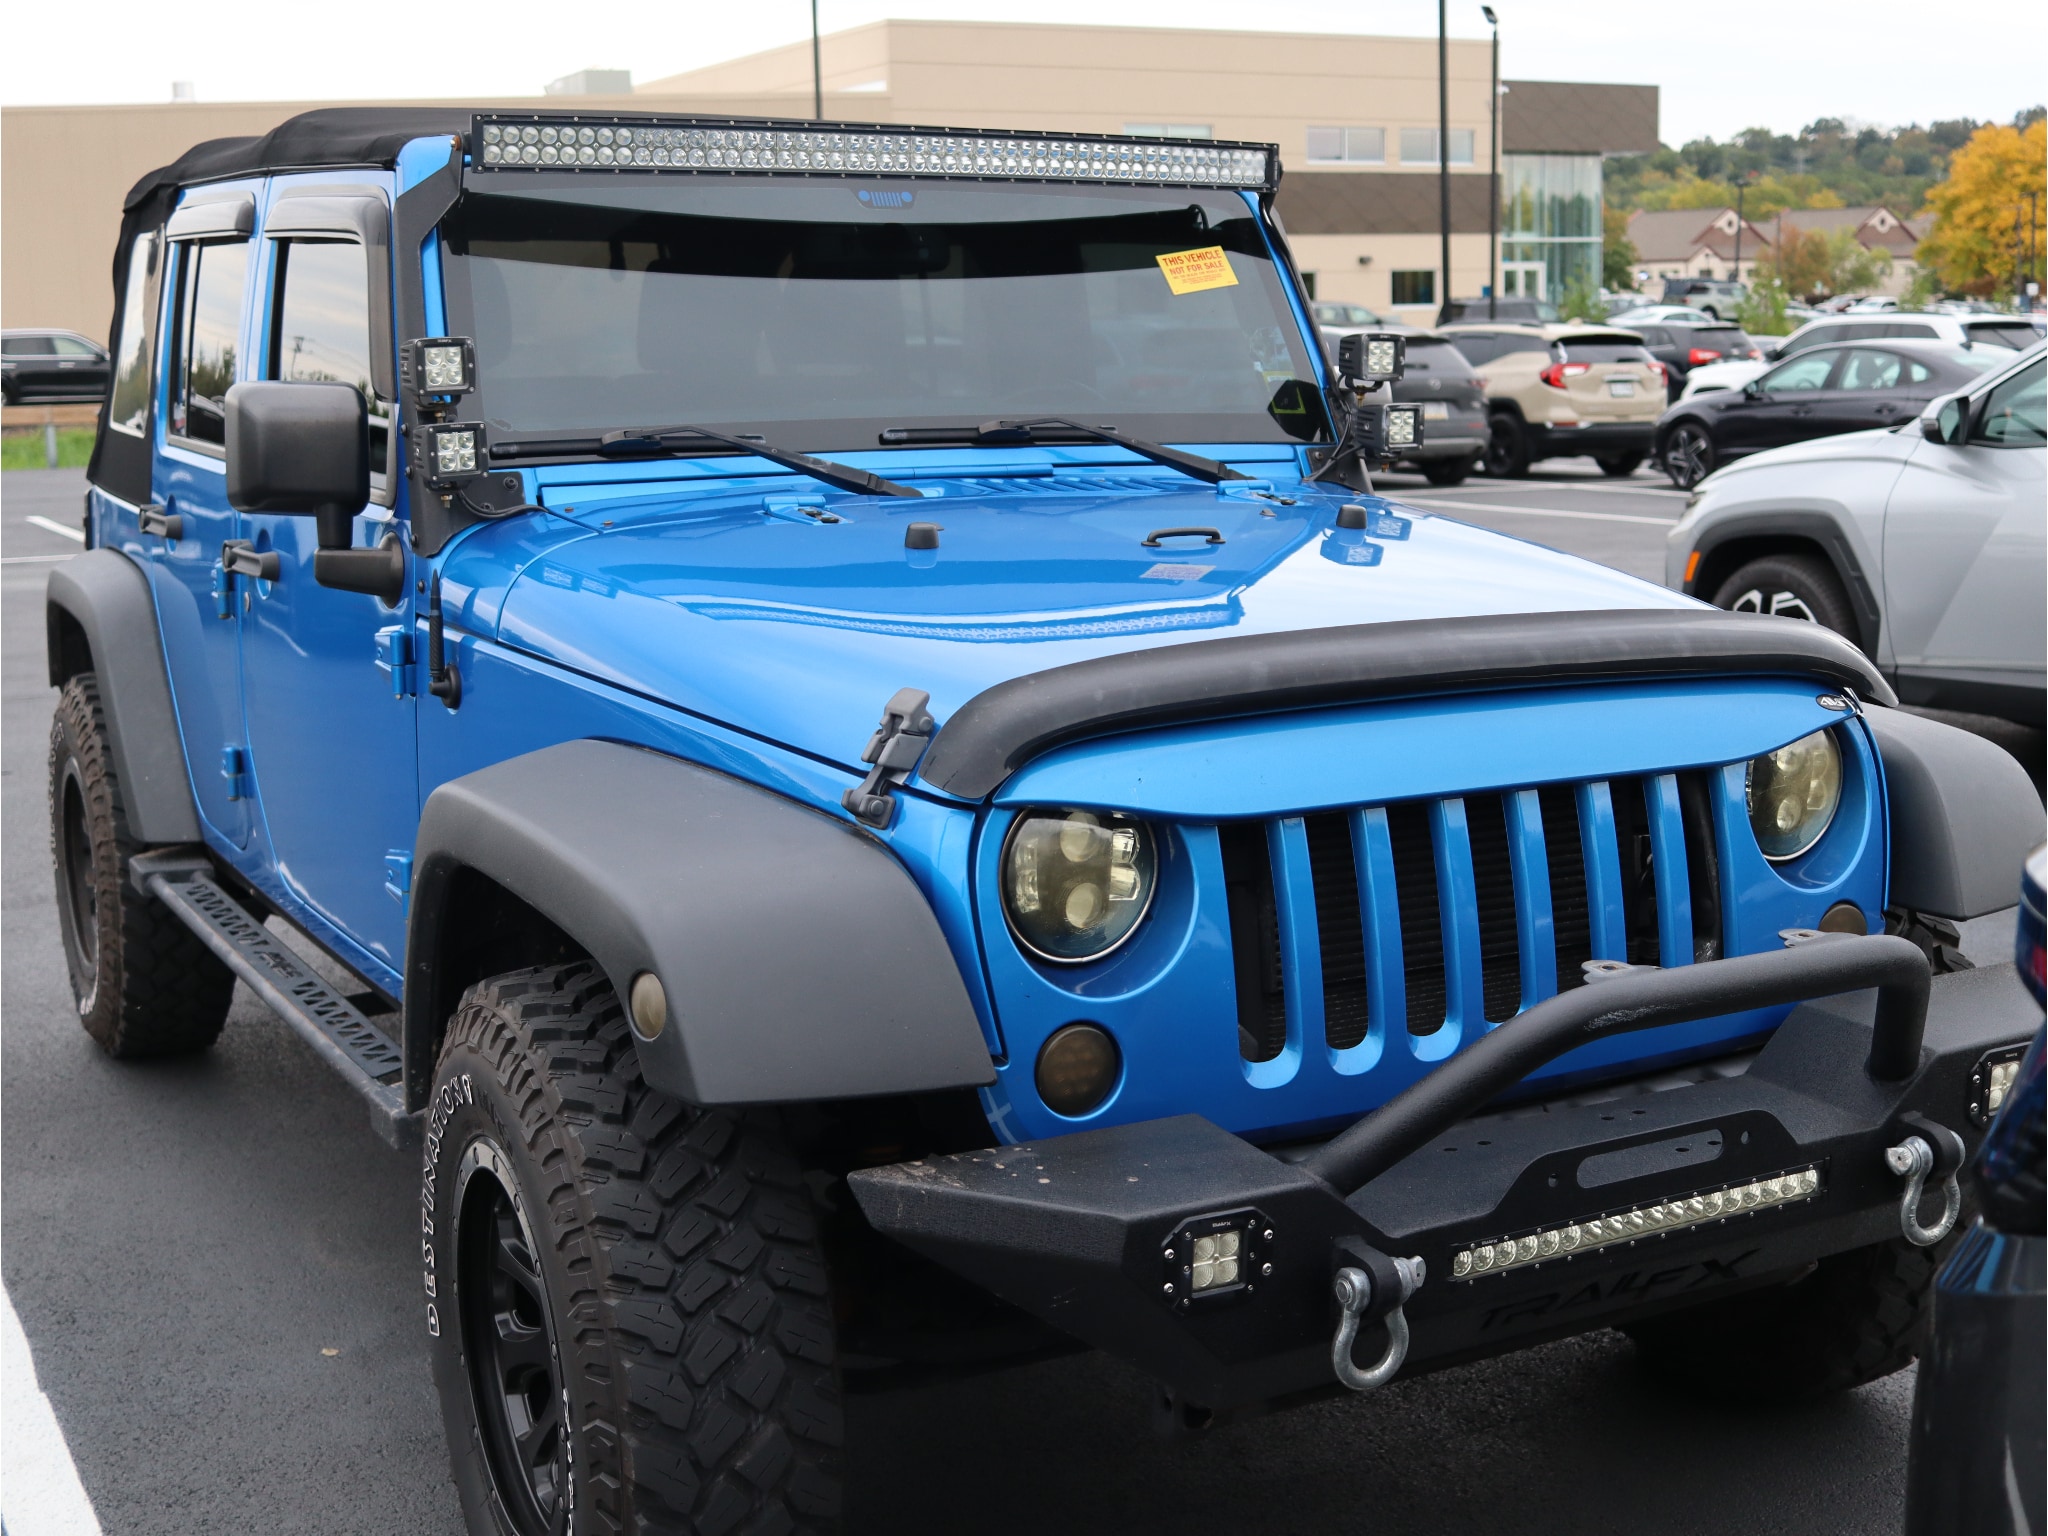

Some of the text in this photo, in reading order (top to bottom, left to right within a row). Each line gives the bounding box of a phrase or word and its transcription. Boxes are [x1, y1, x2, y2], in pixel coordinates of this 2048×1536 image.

[1162, 250, 1222, 267] THIS VEHICLE
[1169, 266, 1185, 275] NOT
[1187, 263, 1203, 272] FOR
[1205, 260, 1224, 270] SALE
